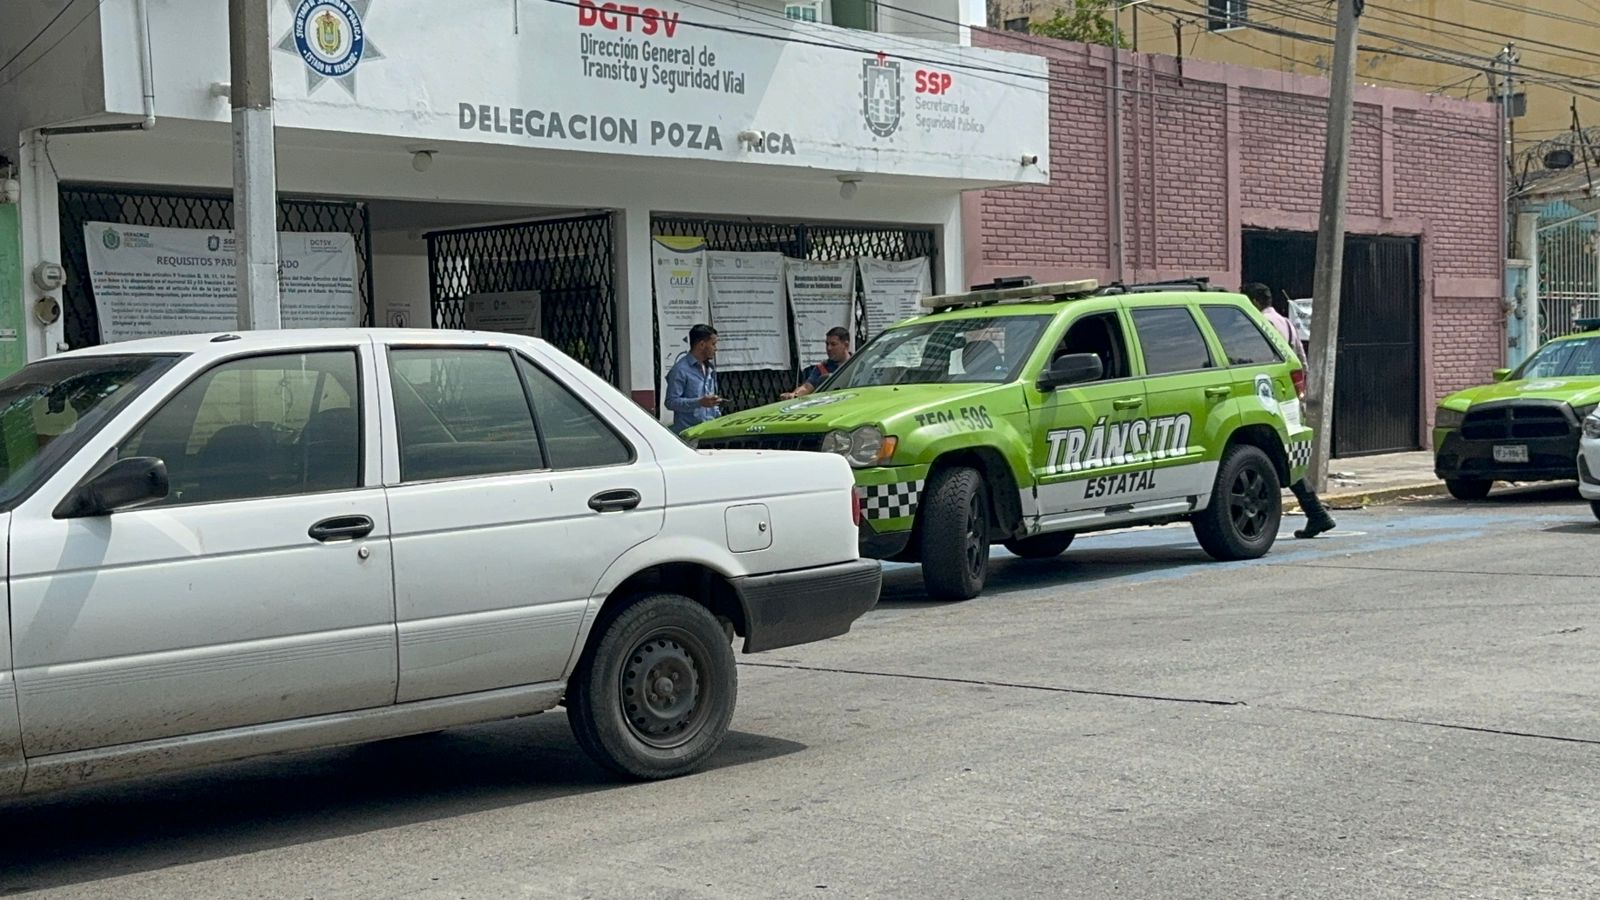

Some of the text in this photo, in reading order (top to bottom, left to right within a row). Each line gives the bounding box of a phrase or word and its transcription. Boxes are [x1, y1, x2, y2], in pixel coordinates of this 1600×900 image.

[578, 0, 679, 38] DGTSV
[580, 32, 716, 67] Dirección General de
[580, 55, 745, 95] Transito y Seguridad Vial
[915, 69, 952, 95] SSP
[915, 113, 956, 133] Seguridad
[960, 100, 970, 115] de
[458, 102, 638, 145] DELEGACION
[650, 120, 723, 151] POZA
[157, 256, 212, 267] REQUISITOS
[280, 260, 299, 268] ADO
[1046, 412, 1192, 475] TRÁNSITO
[1083, 471, 1156, 499] ESTATAL
